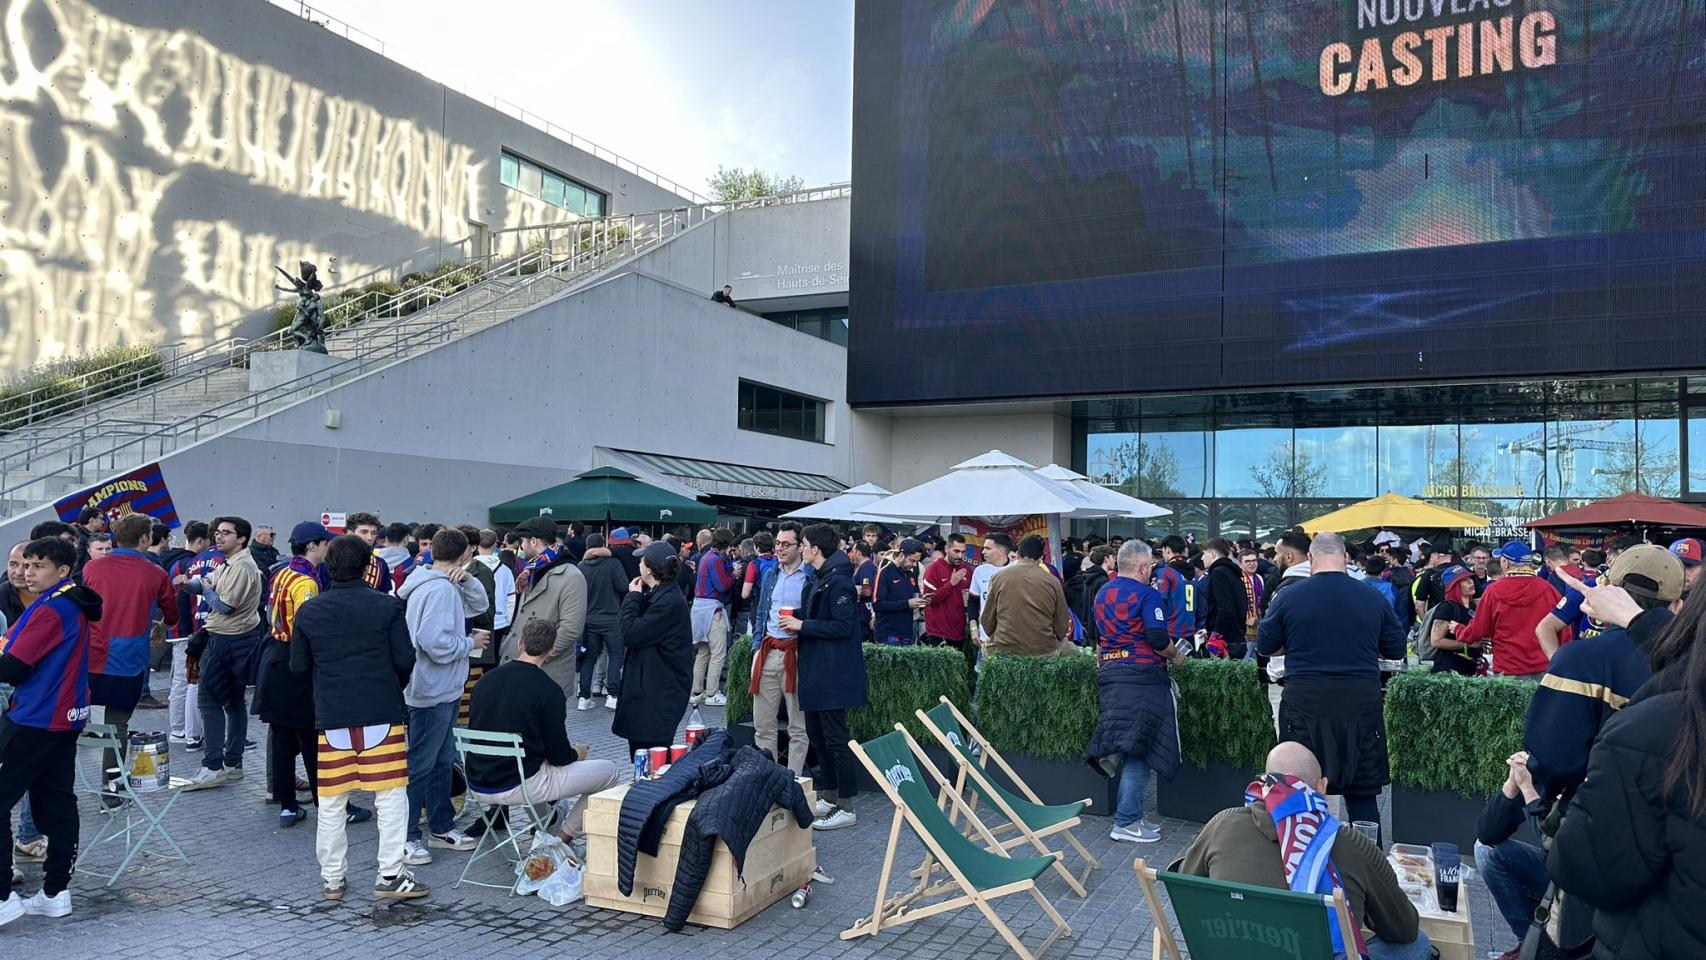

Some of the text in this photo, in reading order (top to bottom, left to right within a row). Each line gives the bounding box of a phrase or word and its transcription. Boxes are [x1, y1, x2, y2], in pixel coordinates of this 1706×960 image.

[1357, 0, 1512, 29] NOUV
[1319, 10, 1556, 96] CASTING
[824, 260, 843, 272] des
[83, 479, 148, 508] AMPIONS
[1424, 484, 1457, 497] MICRO
[1185, 584, 1194, 612] 9
